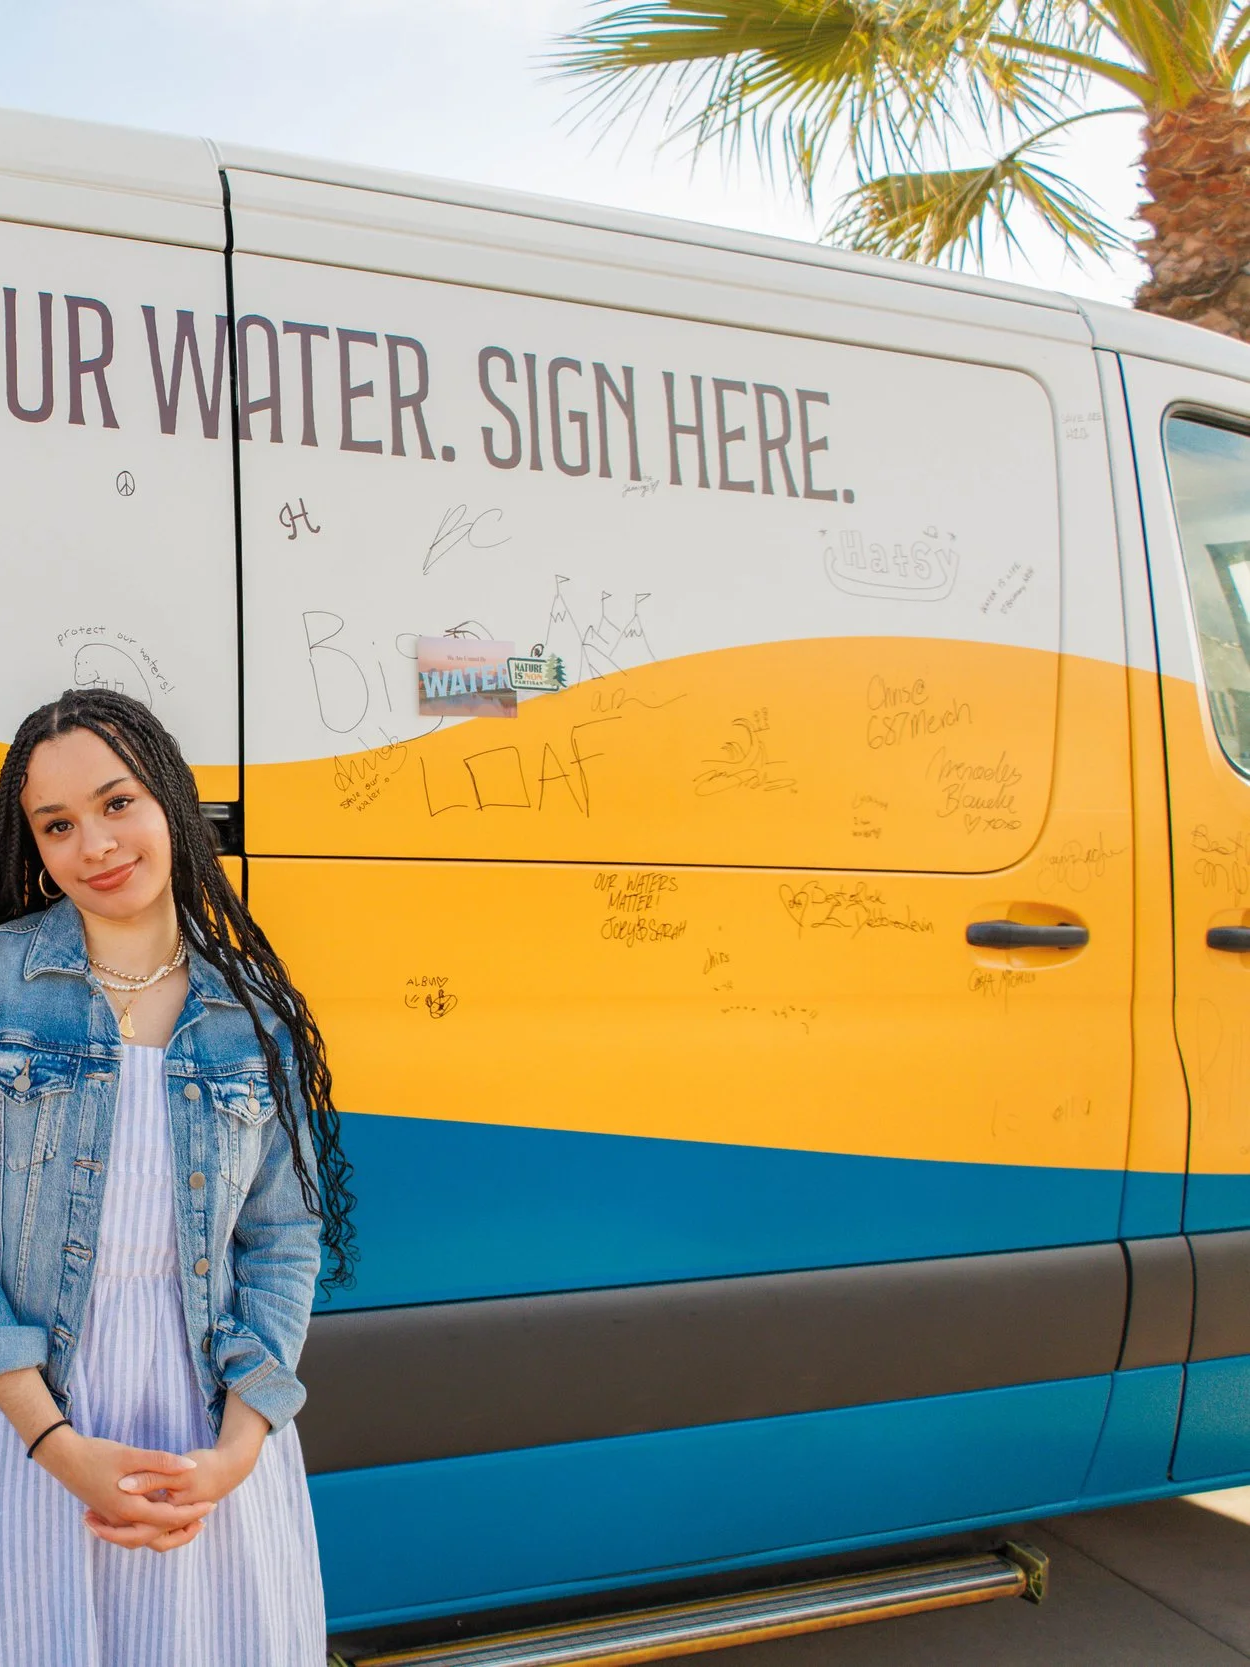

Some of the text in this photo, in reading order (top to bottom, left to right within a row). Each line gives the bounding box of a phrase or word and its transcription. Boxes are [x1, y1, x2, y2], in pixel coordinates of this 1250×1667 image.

[140, 304, 456, 463] WATER.
[477, 346, 643, 482] SIGN
[661, 370, 856, 504] HERE.
[57, 625, 106, 647] protect
[117, 632, 137, 644] our
[514, 662, 543, 673] NATURE
[421, 662, 512, 698] WATER
[594, 872, 679, 893] OUR WATERS
